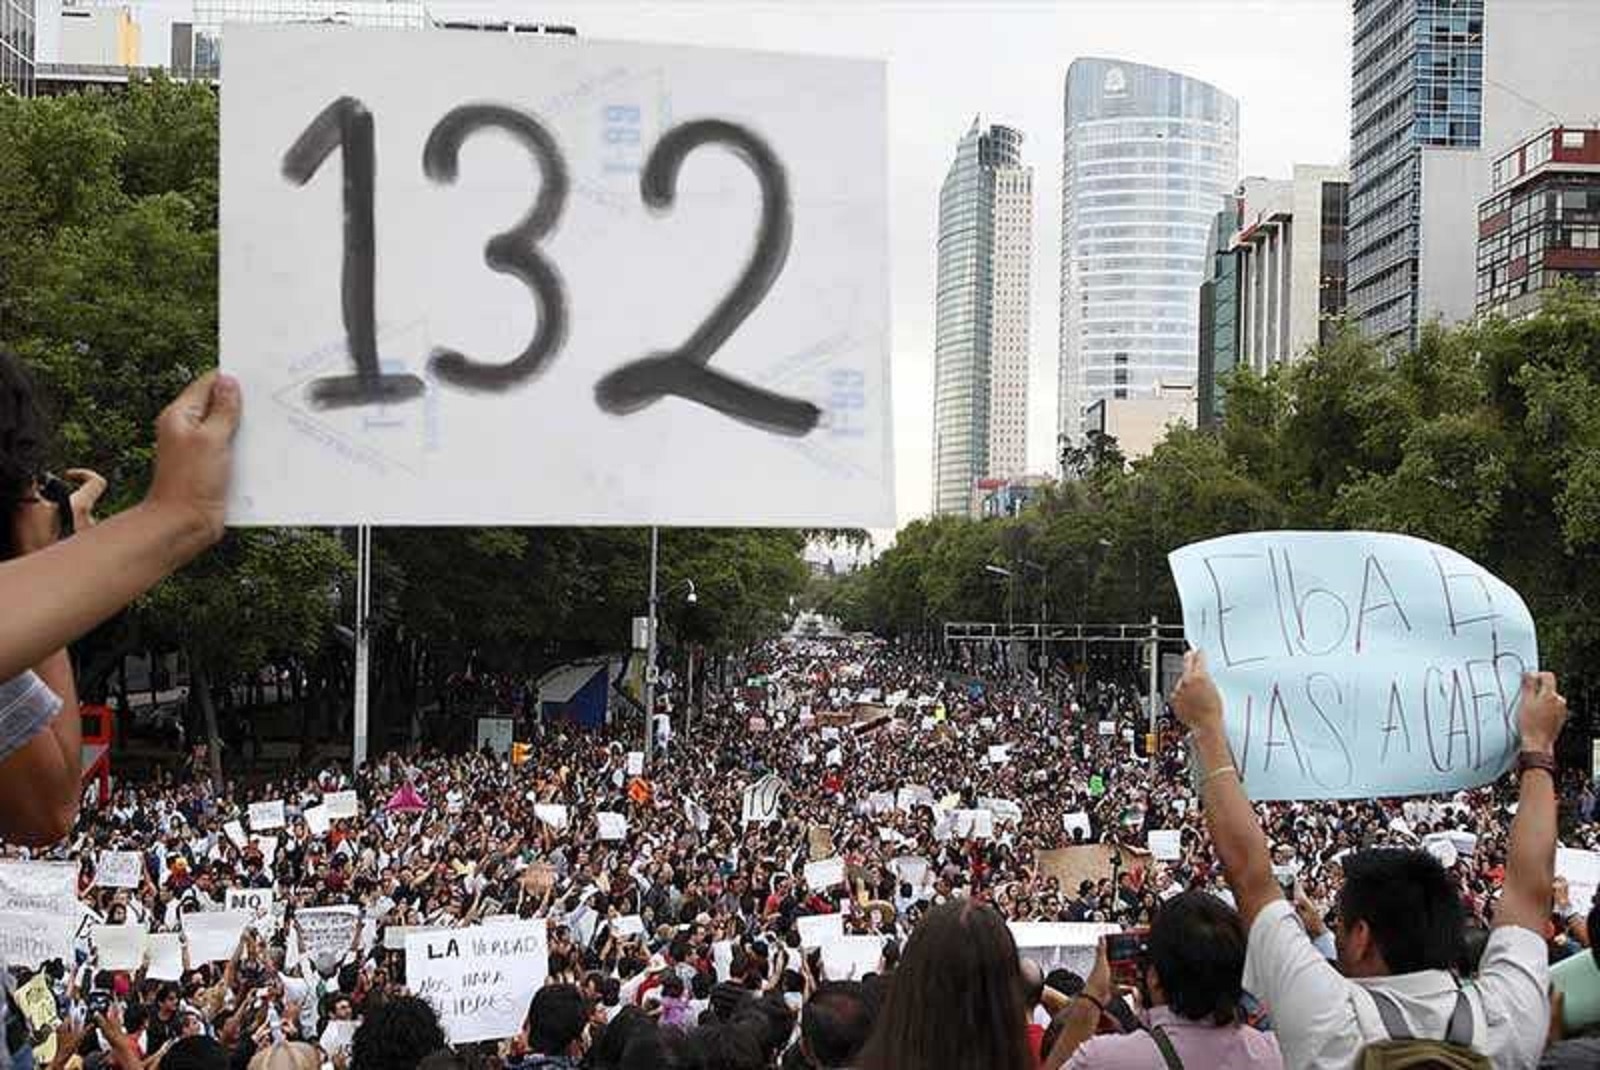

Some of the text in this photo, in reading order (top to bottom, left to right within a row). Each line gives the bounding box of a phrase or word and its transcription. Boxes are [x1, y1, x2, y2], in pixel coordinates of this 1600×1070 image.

[279, 94, 823, 437] 132
[231, 893, 262, 910] NO
[427, 937, 460, 959] LA
